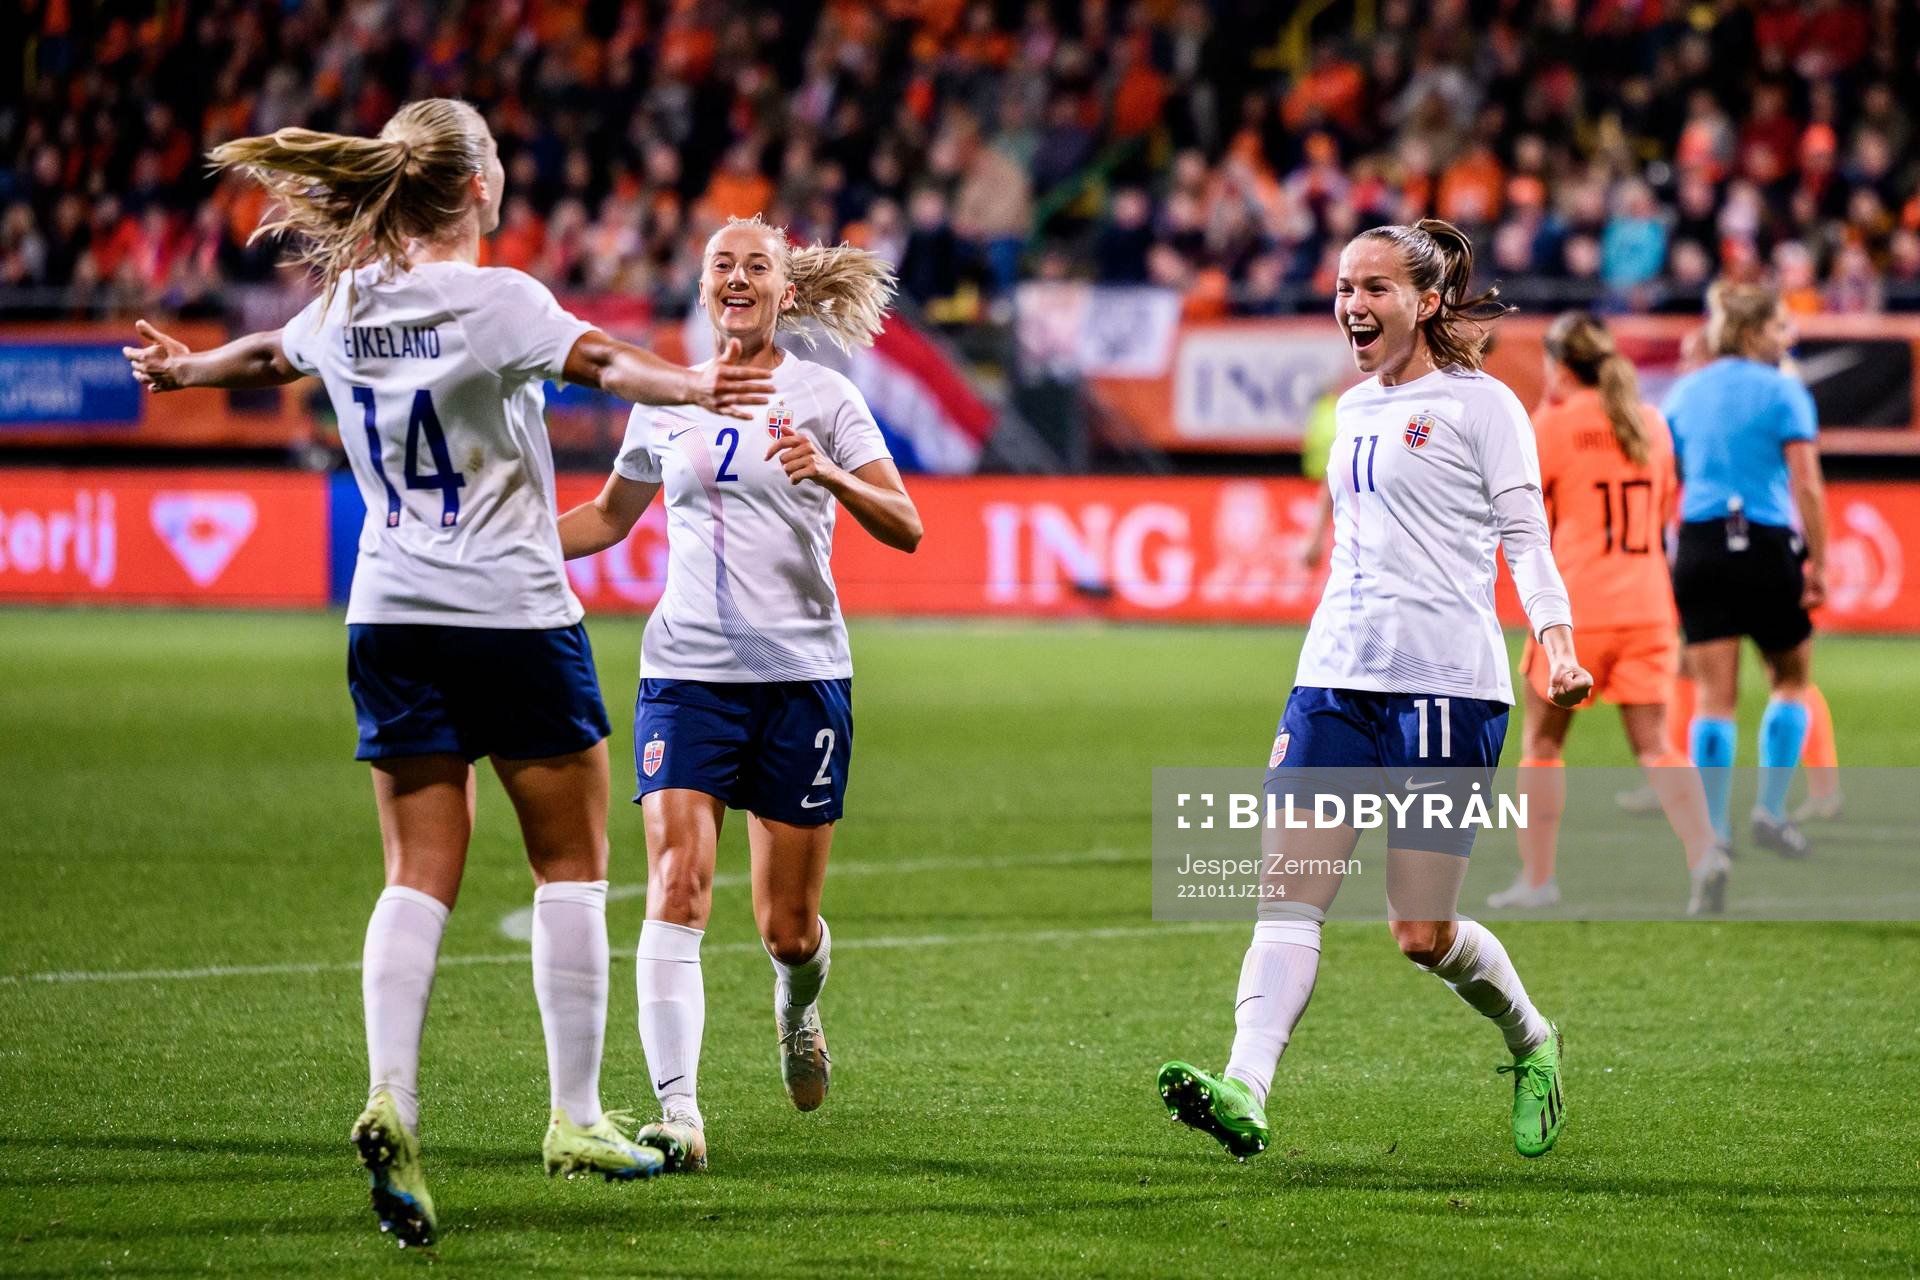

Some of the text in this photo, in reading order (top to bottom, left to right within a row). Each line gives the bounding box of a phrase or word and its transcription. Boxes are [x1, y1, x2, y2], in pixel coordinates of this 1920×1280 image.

[344, 326, 441, 359] EIKELAND
[352, 386, 467, 528] 14
[715, 427, 739, 483] 2
[1352, 435, 1379, 493] 11
[0, 488, 117, 588] erij
[1593, 479, 1652, 556] 10
[982, 503, 1196, 608] ING
[812, 728, 836, 786] 2
[1413, 698, 1451, 758] 11
